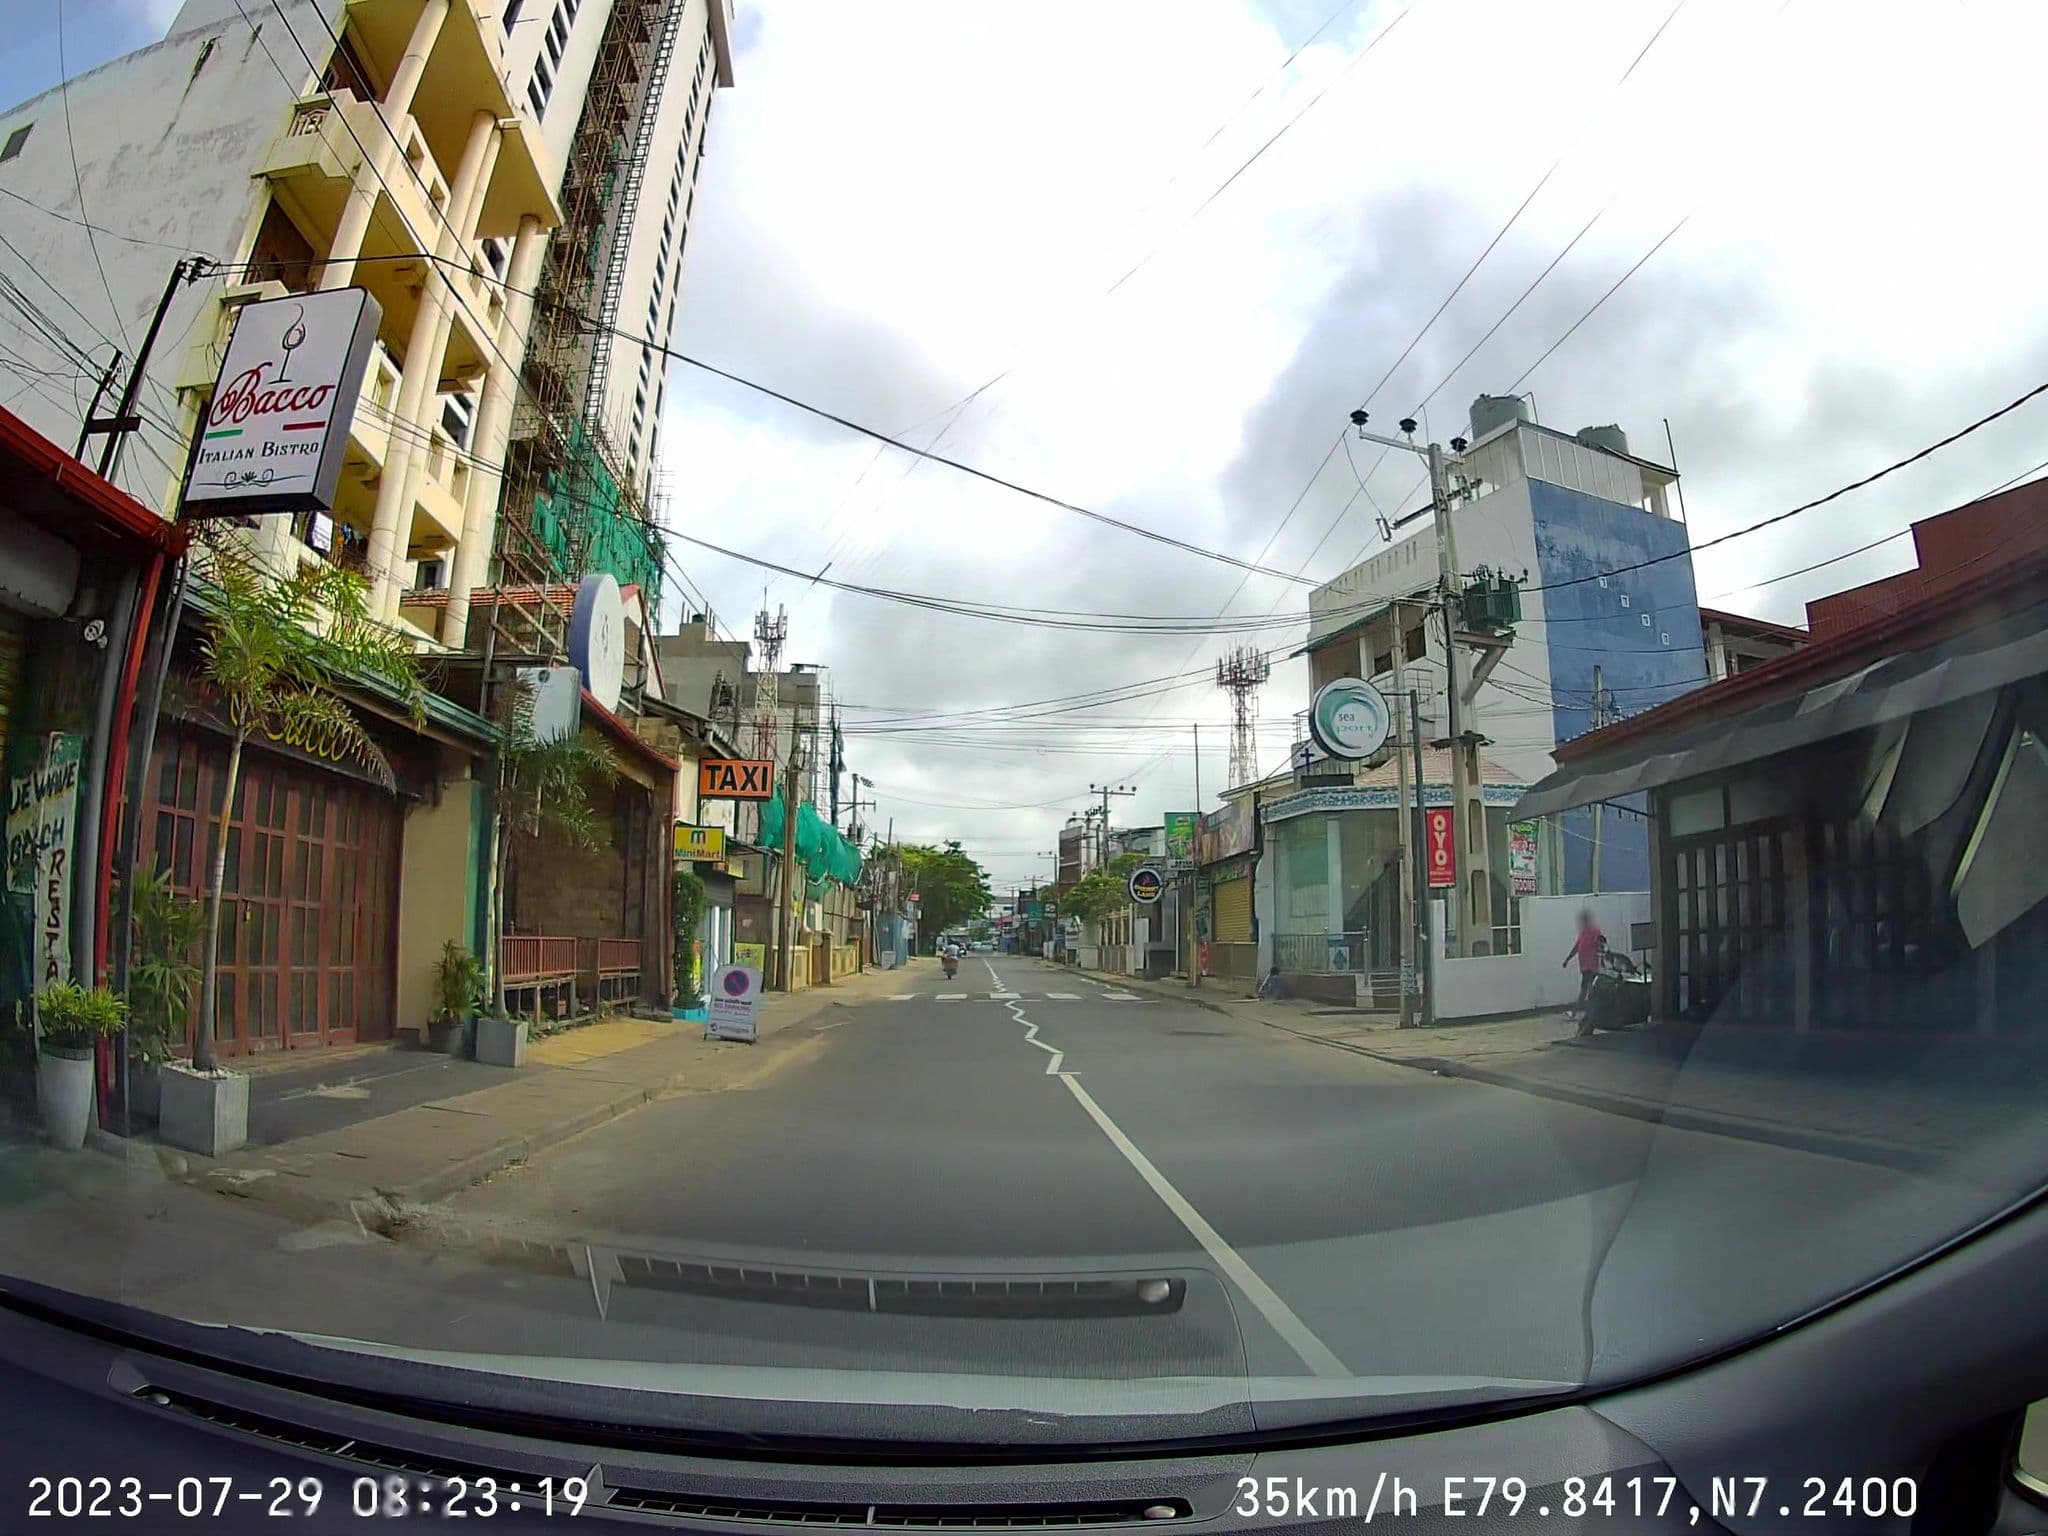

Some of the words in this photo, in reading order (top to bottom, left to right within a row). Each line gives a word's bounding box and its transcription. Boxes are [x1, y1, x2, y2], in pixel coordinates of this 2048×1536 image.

[210, 362, 336, 426] Bacco
[1338, 713, 1355, 722] sea
[33, 761, 77, 803] WAVE
[705, 765, 768, 792] TAXI
[1433, 815, 1448, 866] OYO
